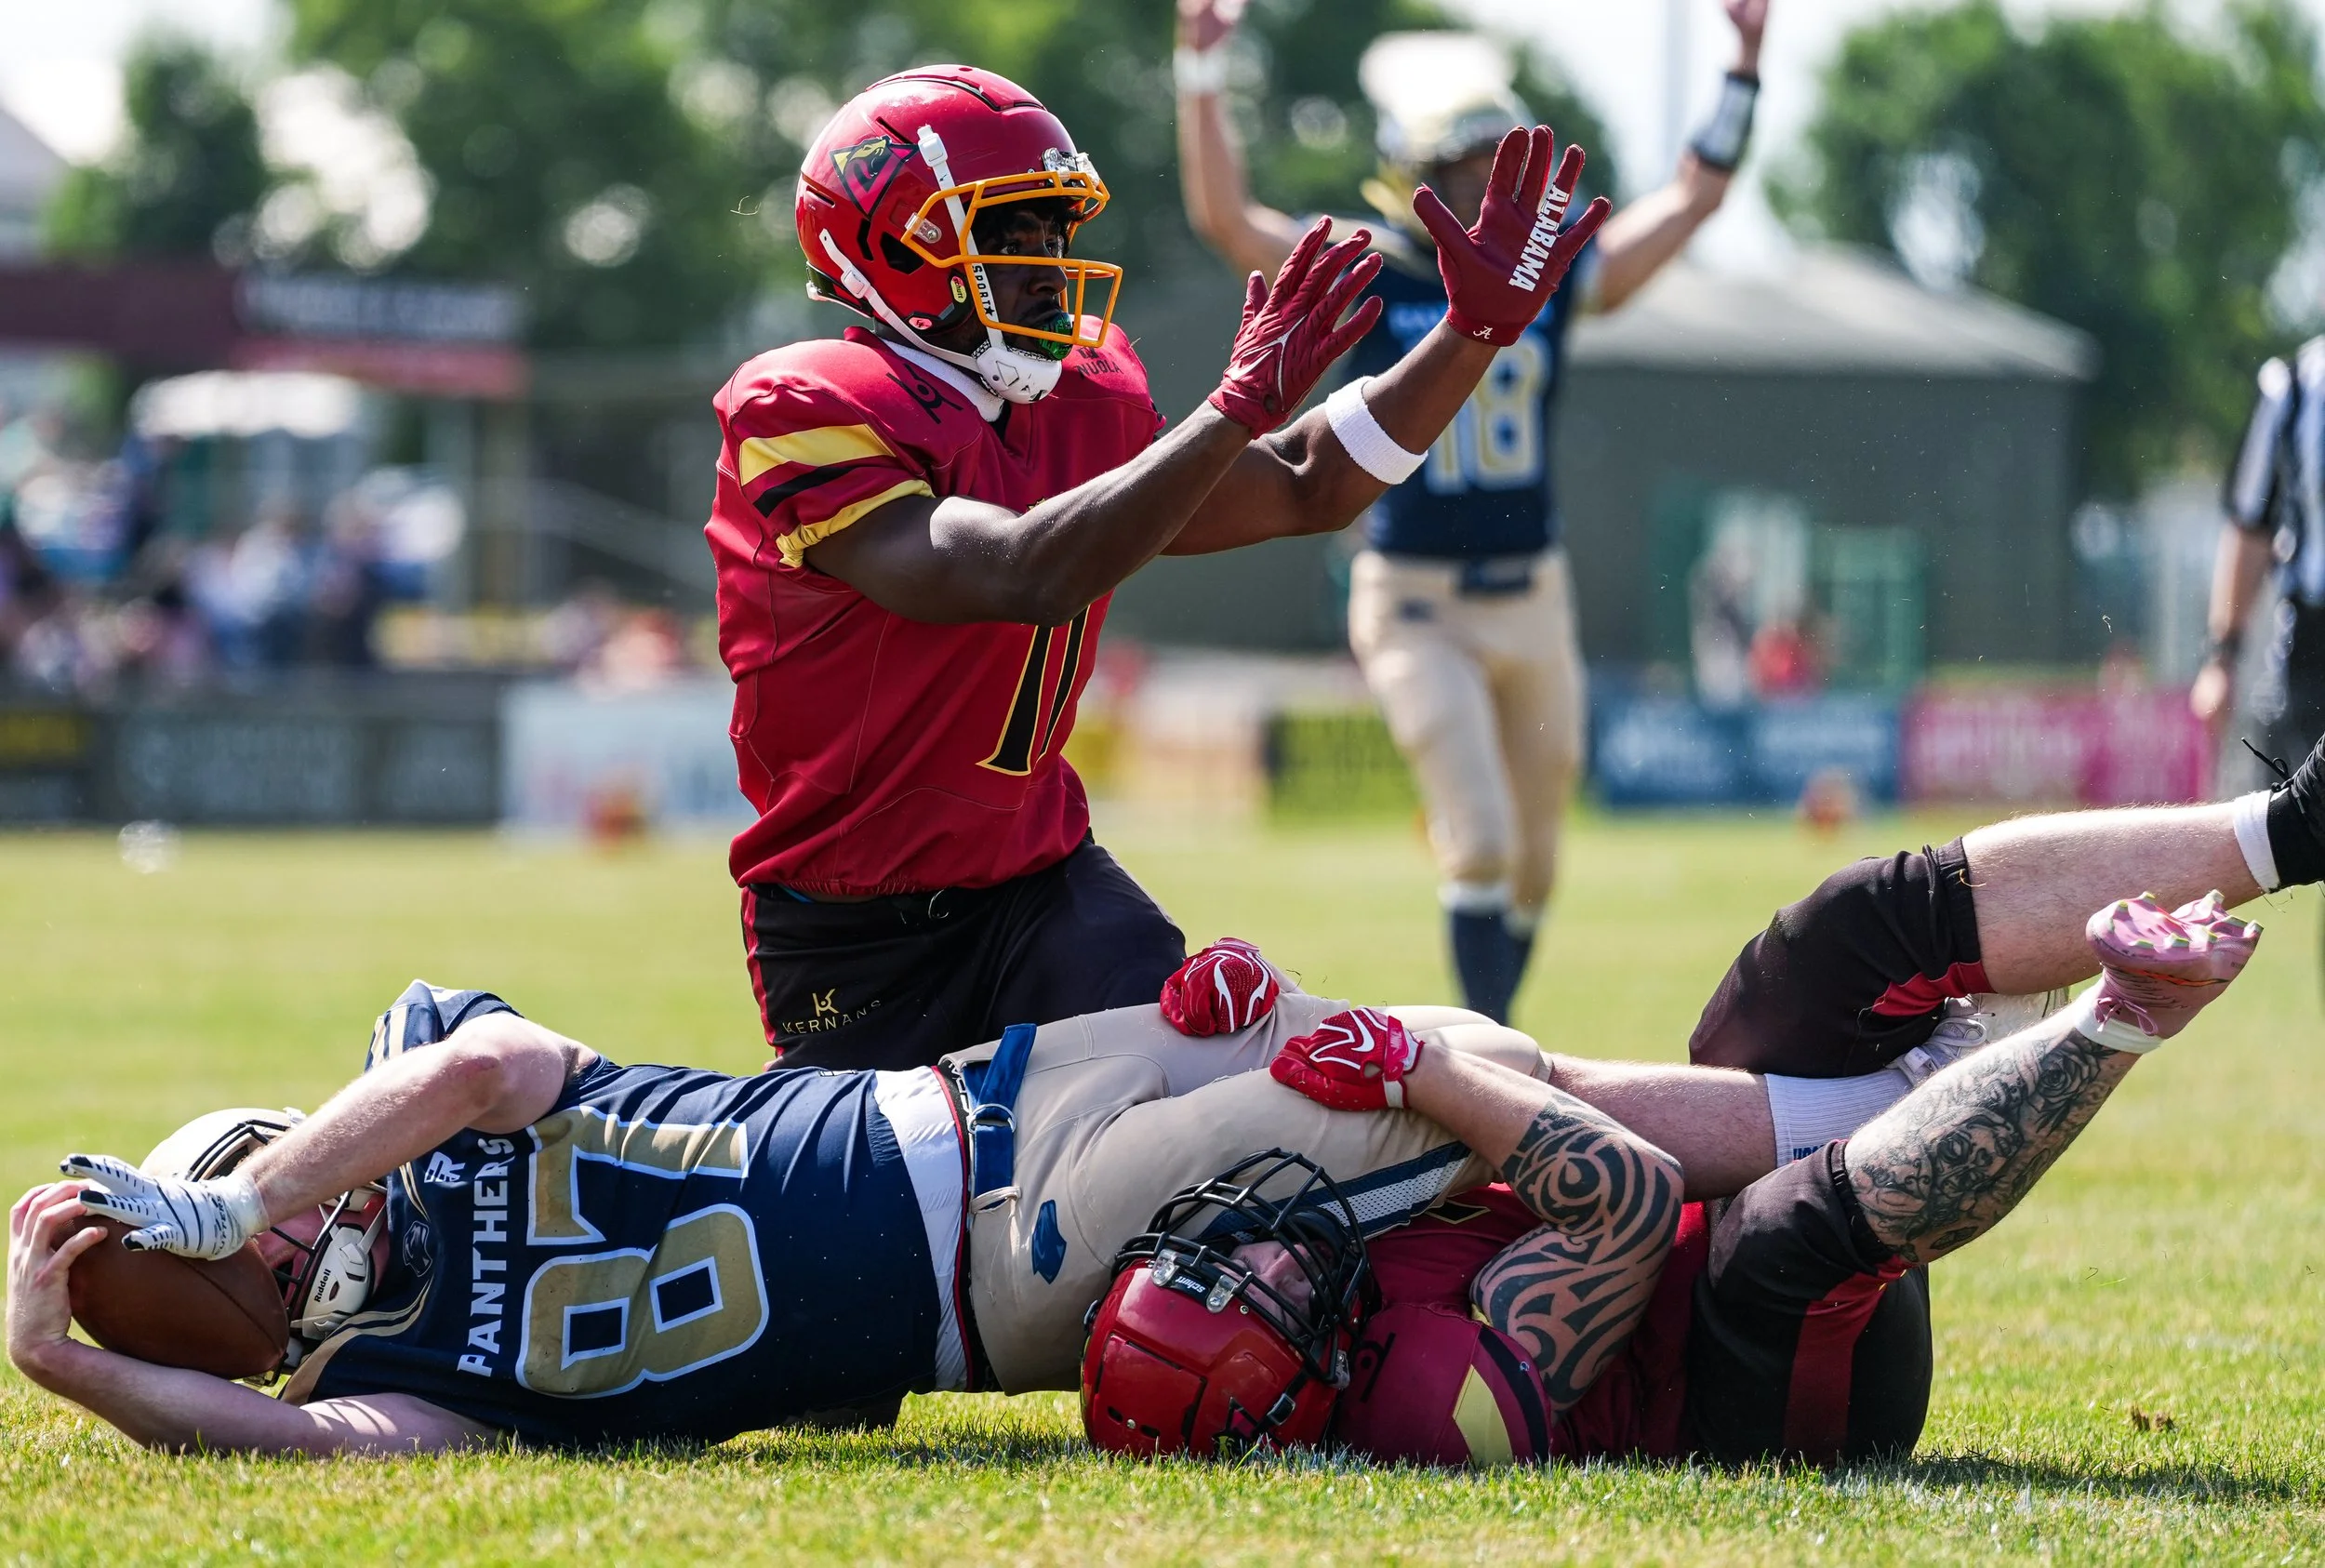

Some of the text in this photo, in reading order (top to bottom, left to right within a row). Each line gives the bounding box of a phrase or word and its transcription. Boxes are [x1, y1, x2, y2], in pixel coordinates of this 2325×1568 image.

[1508, 185, 1570, 292] ALABAMA
[972, 265, 991, 306] SPORT
[1076, 359, 1123, 376] NUOLA
[457, 1137, 516, 1377] PANTHERS
[514, 1105, 770, 1400] 87
[313, 1269, 332, 1303] Riddell
[1175, 1275, 1206, 1294] schutt
